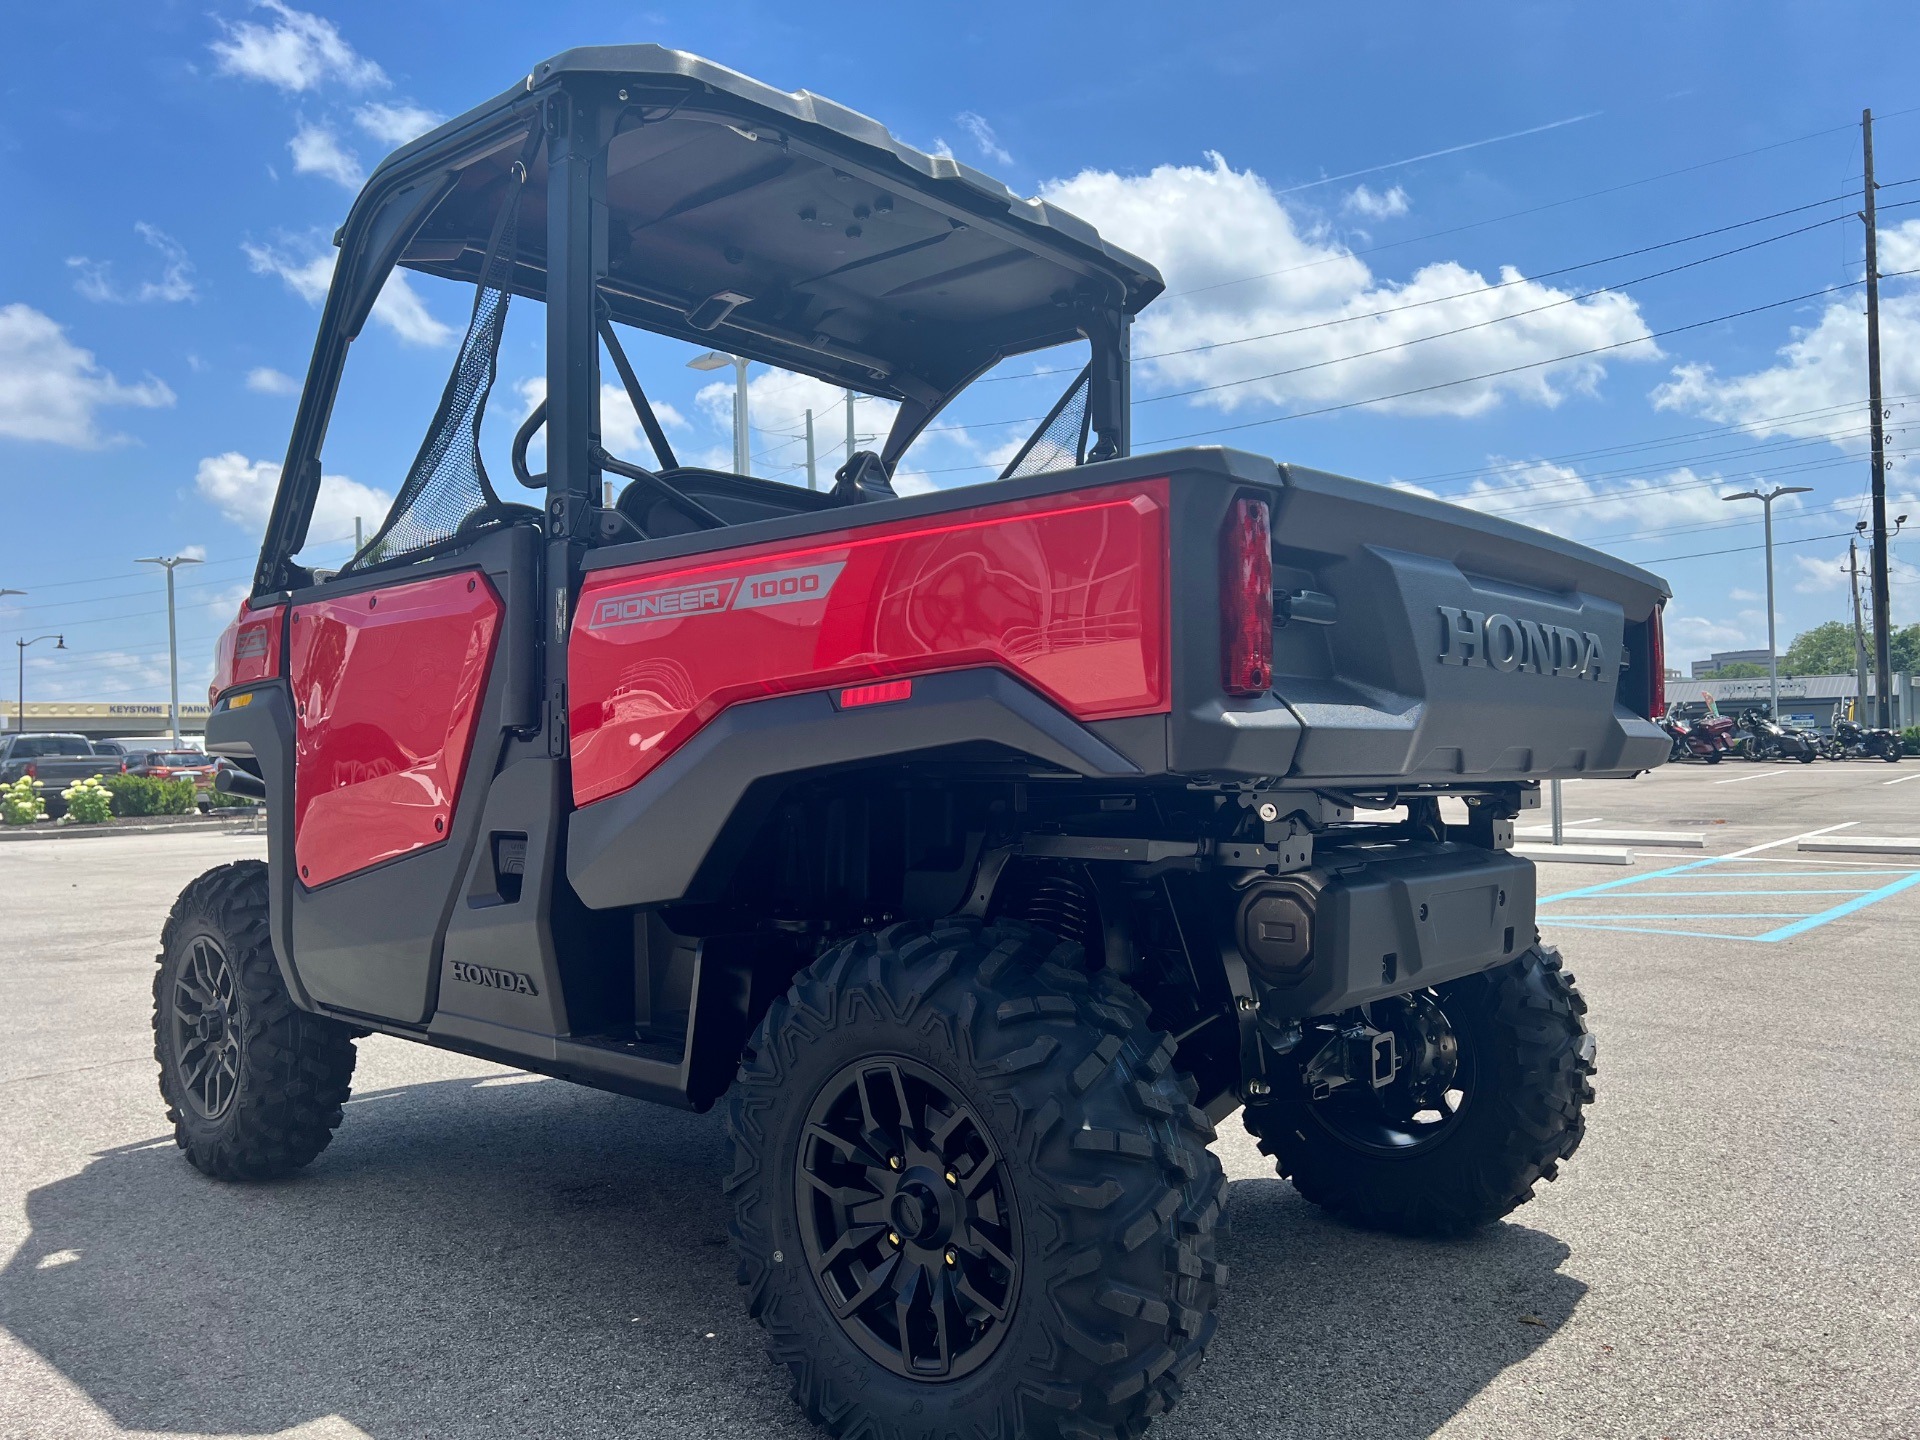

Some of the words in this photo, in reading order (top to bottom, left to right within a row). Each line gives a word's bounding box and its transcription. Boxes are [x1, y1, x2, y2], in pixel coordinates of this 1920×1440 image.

[602, 588, 719, 621] PIONEER
[751, 575, 818, 599] 1000
[1438, 606, 1610, 682] HONDA
[109, 705, 162, 714] KEYSTONE
[451, 961, 539, 996] HONDA
